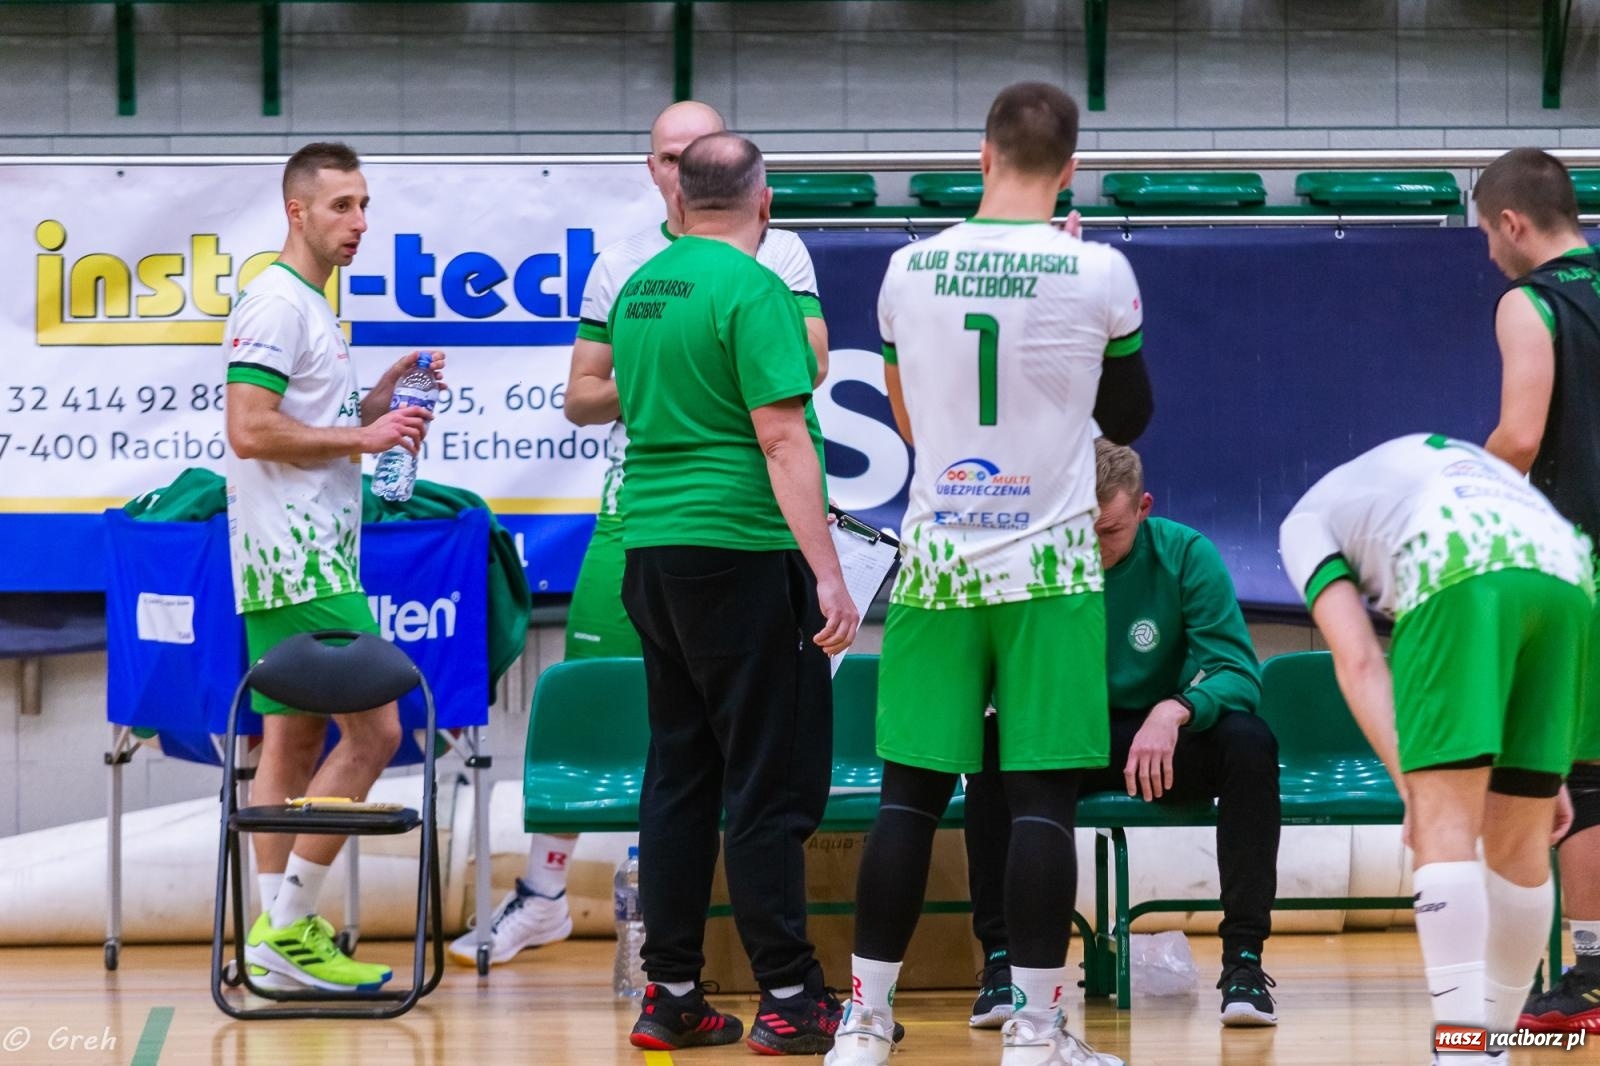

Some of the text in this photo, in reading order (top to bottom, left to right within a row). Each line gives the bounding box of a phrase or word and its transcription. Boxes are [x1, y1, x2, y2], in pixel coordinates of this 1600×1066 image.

[907, 251, 1080, 275] KLUB SIATKARSKI
[641, 279, 695, 299] SIATKARSKI
[935, 274, 1038, 298] RACIBÓRZ
[625, 301, 667, 319] RACIBÓRZ
[963, 313, 999, 426] 1
[8, 386, 48, 412] 32
[61, 386, 126, 412] 414
[138, 386, 177, 413] 92
[812, 348, 910, 511] S
[112, 431, 226, 460] Racibó
[936, 485, 1031, 496] UBEZPIECZENIA
[992, 476, 1031, 484] MULTI
